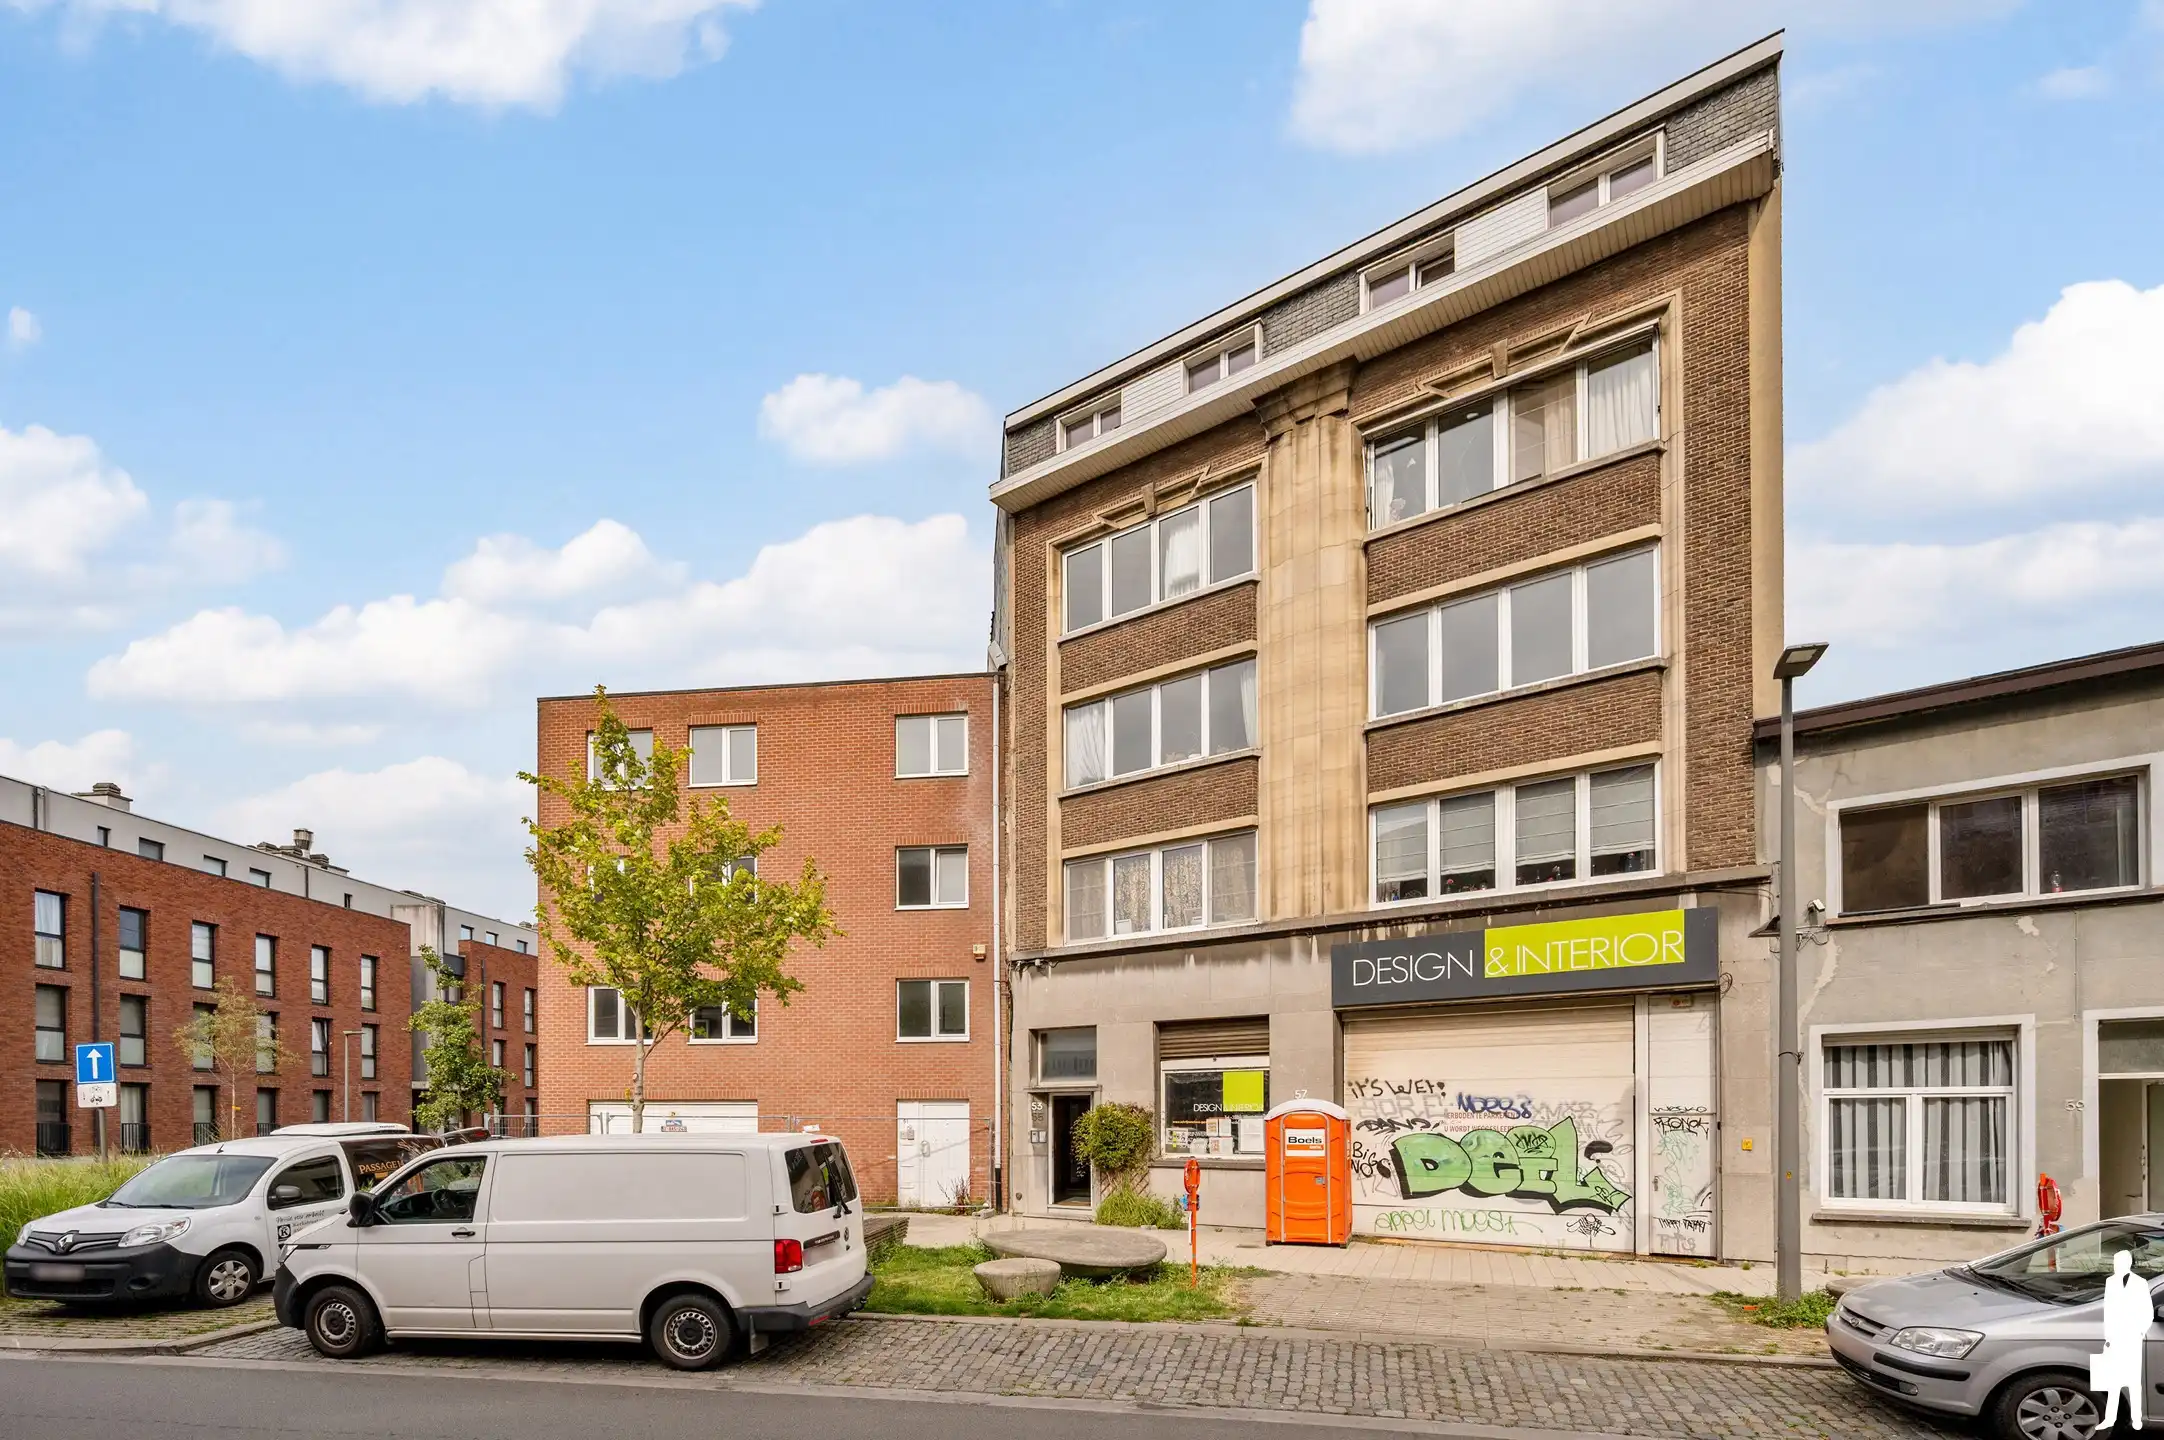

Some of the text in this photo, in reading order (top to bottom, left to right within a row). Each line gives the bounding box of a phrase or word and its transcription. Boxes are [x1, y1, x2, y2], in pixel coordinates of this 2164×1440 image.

[1352, 930, 1683, 987] DESIGN & INTERIOR
[1294, 1089, 1308, 1100] 57
[1031, 1101, 1043, 1111] 53
[1193, 1103, 1223, 1112] DESIGN
[1031, 1112, 1044, 1122] 55
[1288, 1136, 1323, 1144] Boels
